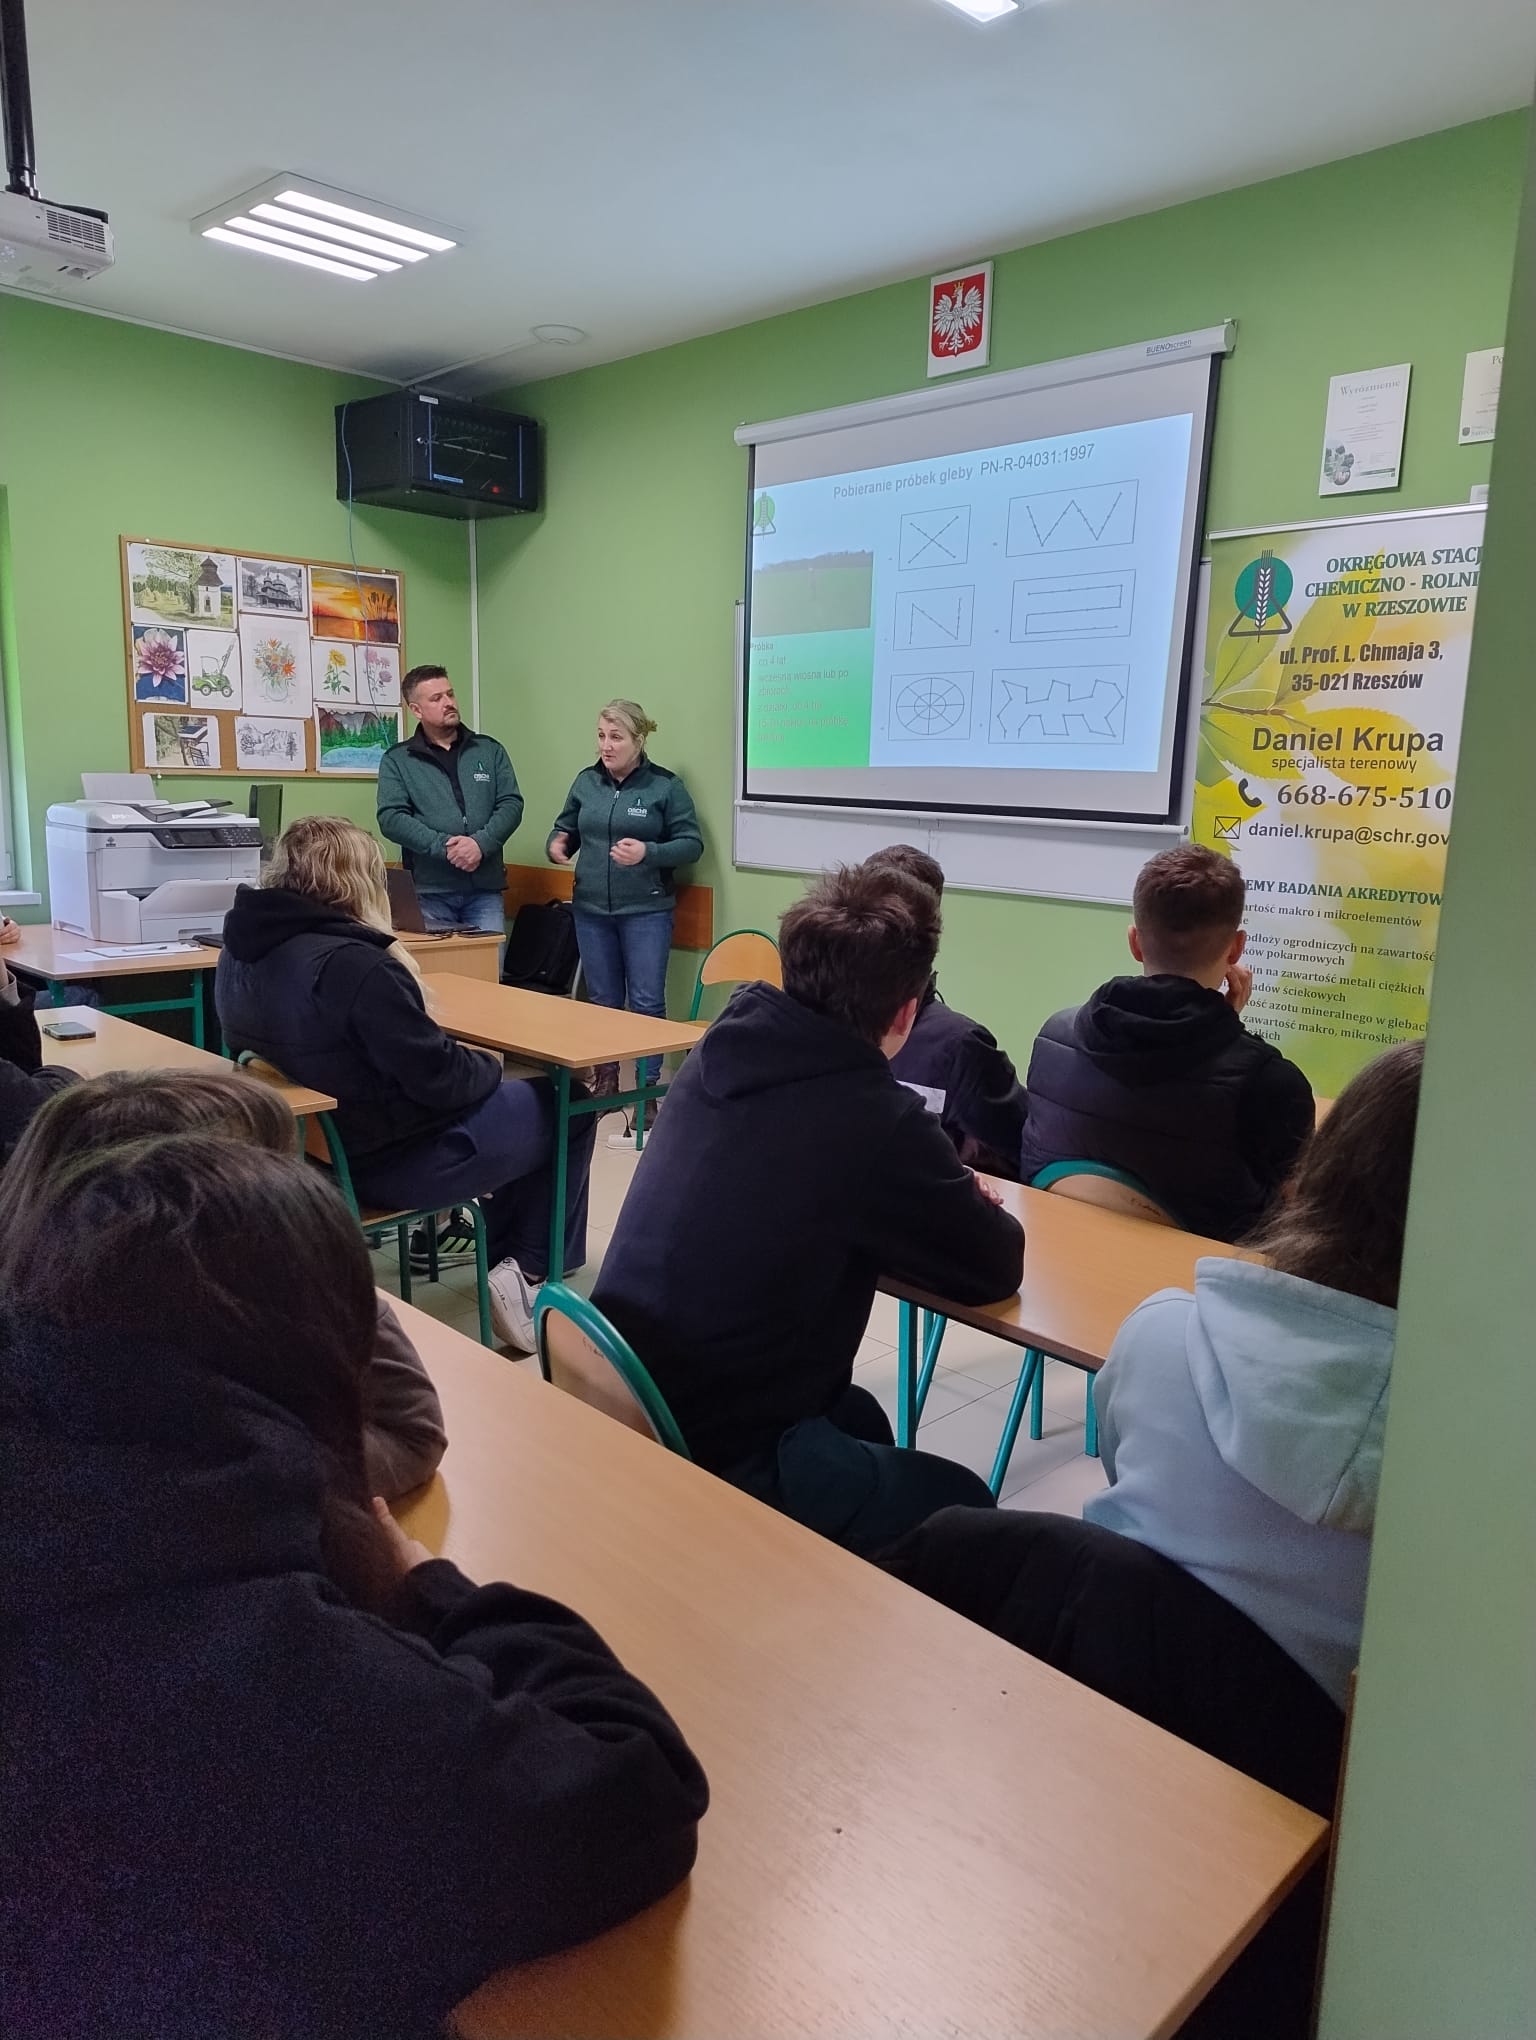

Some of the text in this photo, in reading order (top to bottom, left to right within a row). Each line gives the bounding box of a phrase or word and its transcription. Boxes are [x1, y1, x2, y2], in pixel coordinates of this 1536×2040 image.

[833, 443, 1095, 499] Pobieranie próbek gleby PN-R-04031:1997
[1326, 551, 1426, 573] OKRĘGOWA
[1305, 576, 1405, 597] CHEMICZNO
[1343, 596, 1467, 618] W RZESZOWIE
[1280, 641, 1443, 664] ul. Prof. L. Chmaja 3,
[1292, 671, 1423, 691] 35-021 Rzeszów
[1253, 727, 1444, 757] Daniel Krupa
[1271, 756, 1417, 773] specjalista terenowy
[1278, 784, 1451, 809] 668-675-510
[1249, 823, 1450, 847] daniel.krupa@schr.gov
[1278, 881, 1343, 897] BADANIA
[1278, 906, 1314, 917] makro
[1324, 909, 1422, 927] mikroelementów
[1283, 939, 1357, 953] ogrodniczych
[1361, 946, 1374, 954] na
[1267, 949, 1345, 966] pokarmowych
[1266, 968, 1278, 976] na
[1281, 970, 1337, 984] zawartość
[1340, 977, 1375, 988] metali
[1379, 982, 1425, 995] ciężkich
[1283, 986, 1346, 1002] ściekowych
[1269, 1003, 1298, 1013] azotu
[1301, 1006, 1372, 1024] mineralnego
[1243, 1015, 1296, 1029] zawartość
[1299, 1024, 1337, 1036] makro,
